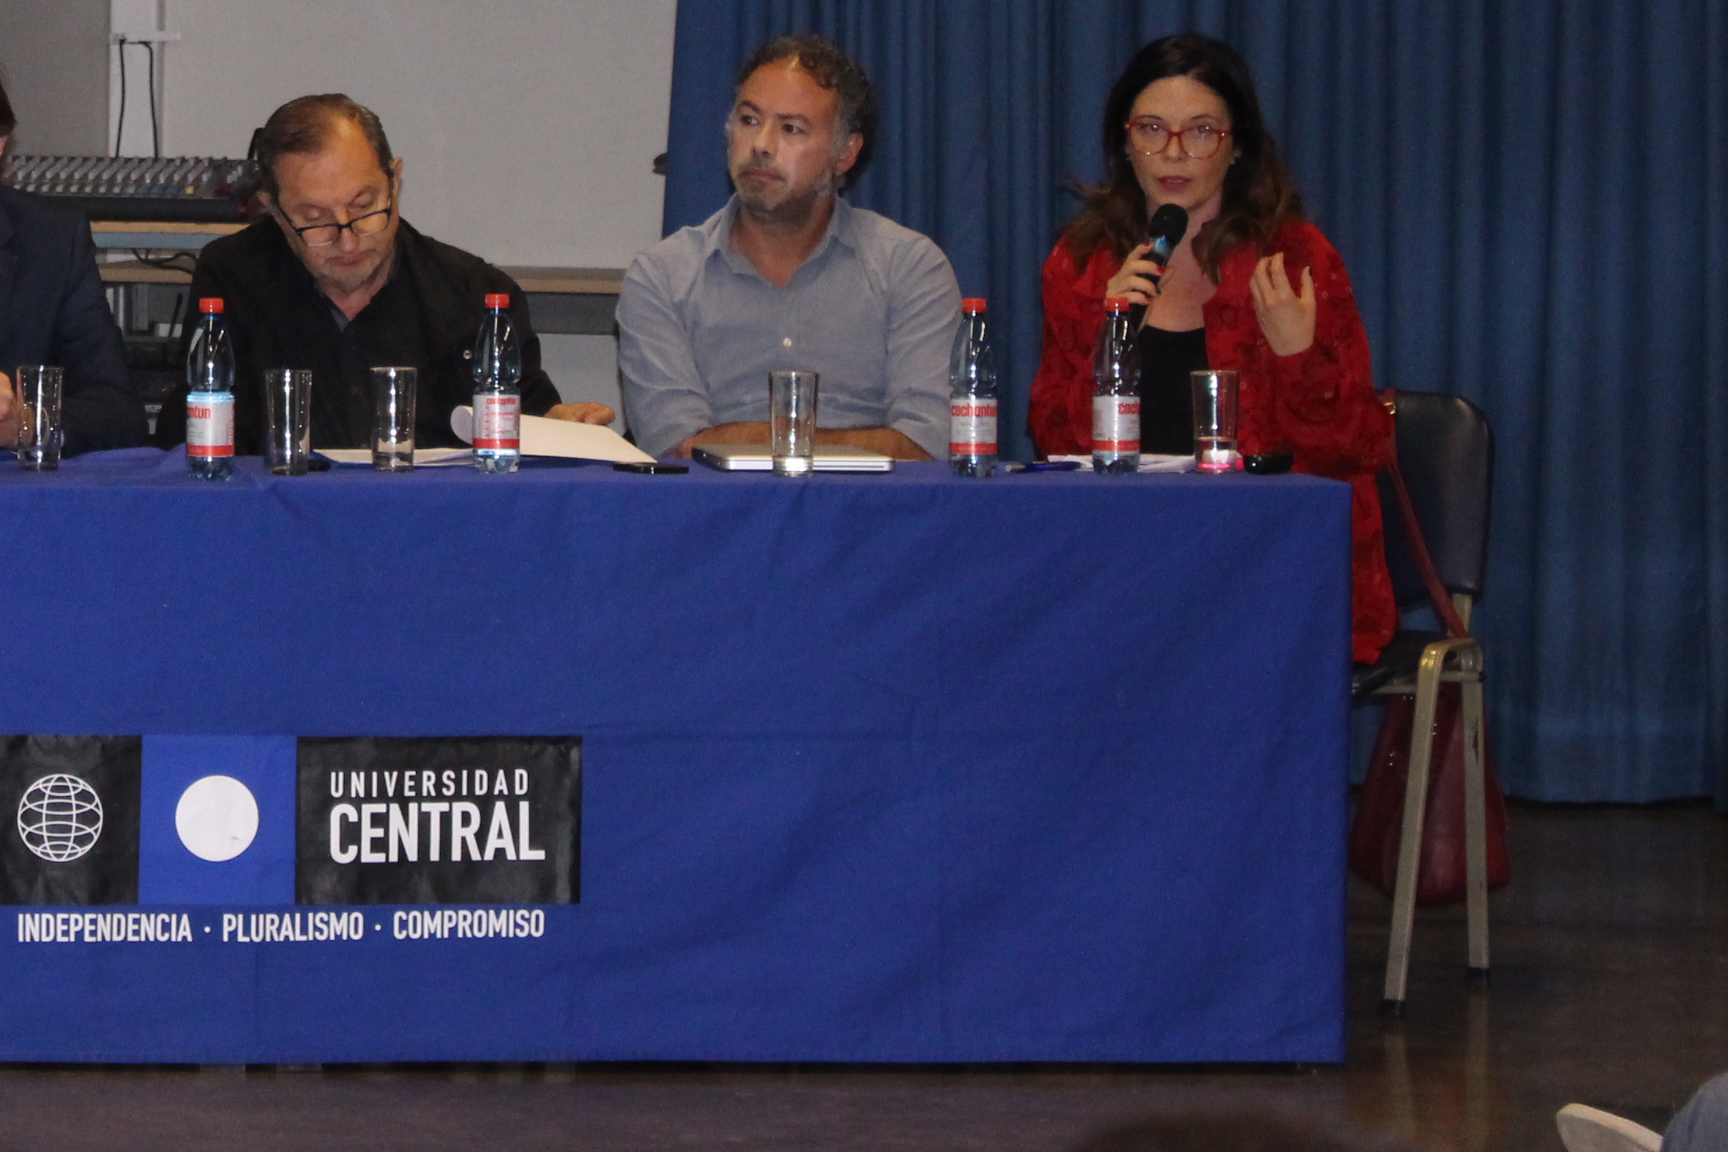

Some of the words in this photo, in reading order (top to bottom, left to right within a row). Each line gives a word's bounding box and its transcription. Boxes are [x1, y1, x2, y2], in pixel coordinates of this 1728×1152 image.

[330, 768, 529, 798] UNIVERSIDAD
[329, 801, 546, 864] CENTRAL
[18, 913, 192, 943] INDEPENDENCIA
[222, 911, 364, 942] PLURALISMO
[393, 909, 545, 940] COMPROMISO
